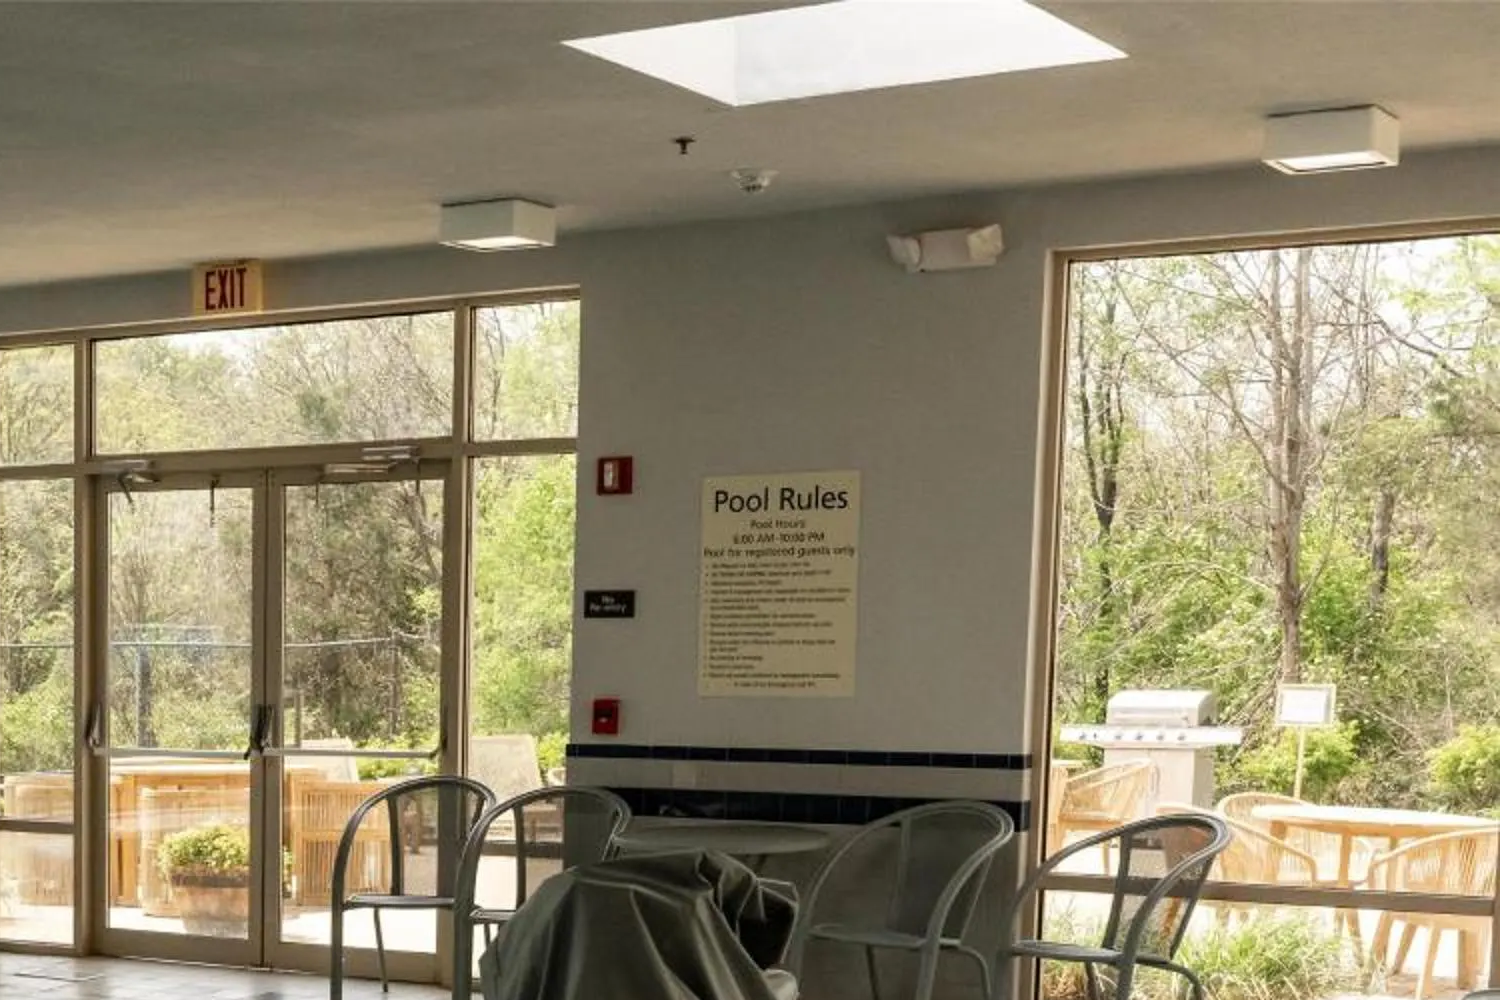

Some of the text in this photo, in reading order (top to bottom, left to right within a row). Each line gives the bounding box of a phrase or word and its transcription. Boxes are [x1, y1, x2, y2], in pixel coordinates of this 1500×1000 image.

[205, 267, 247, 310] EXIT
[714, 484, 849, 513] Pool Rules
[750, 519, 806, 529] Pool Hours
[808, 531, 825, 542] PM
